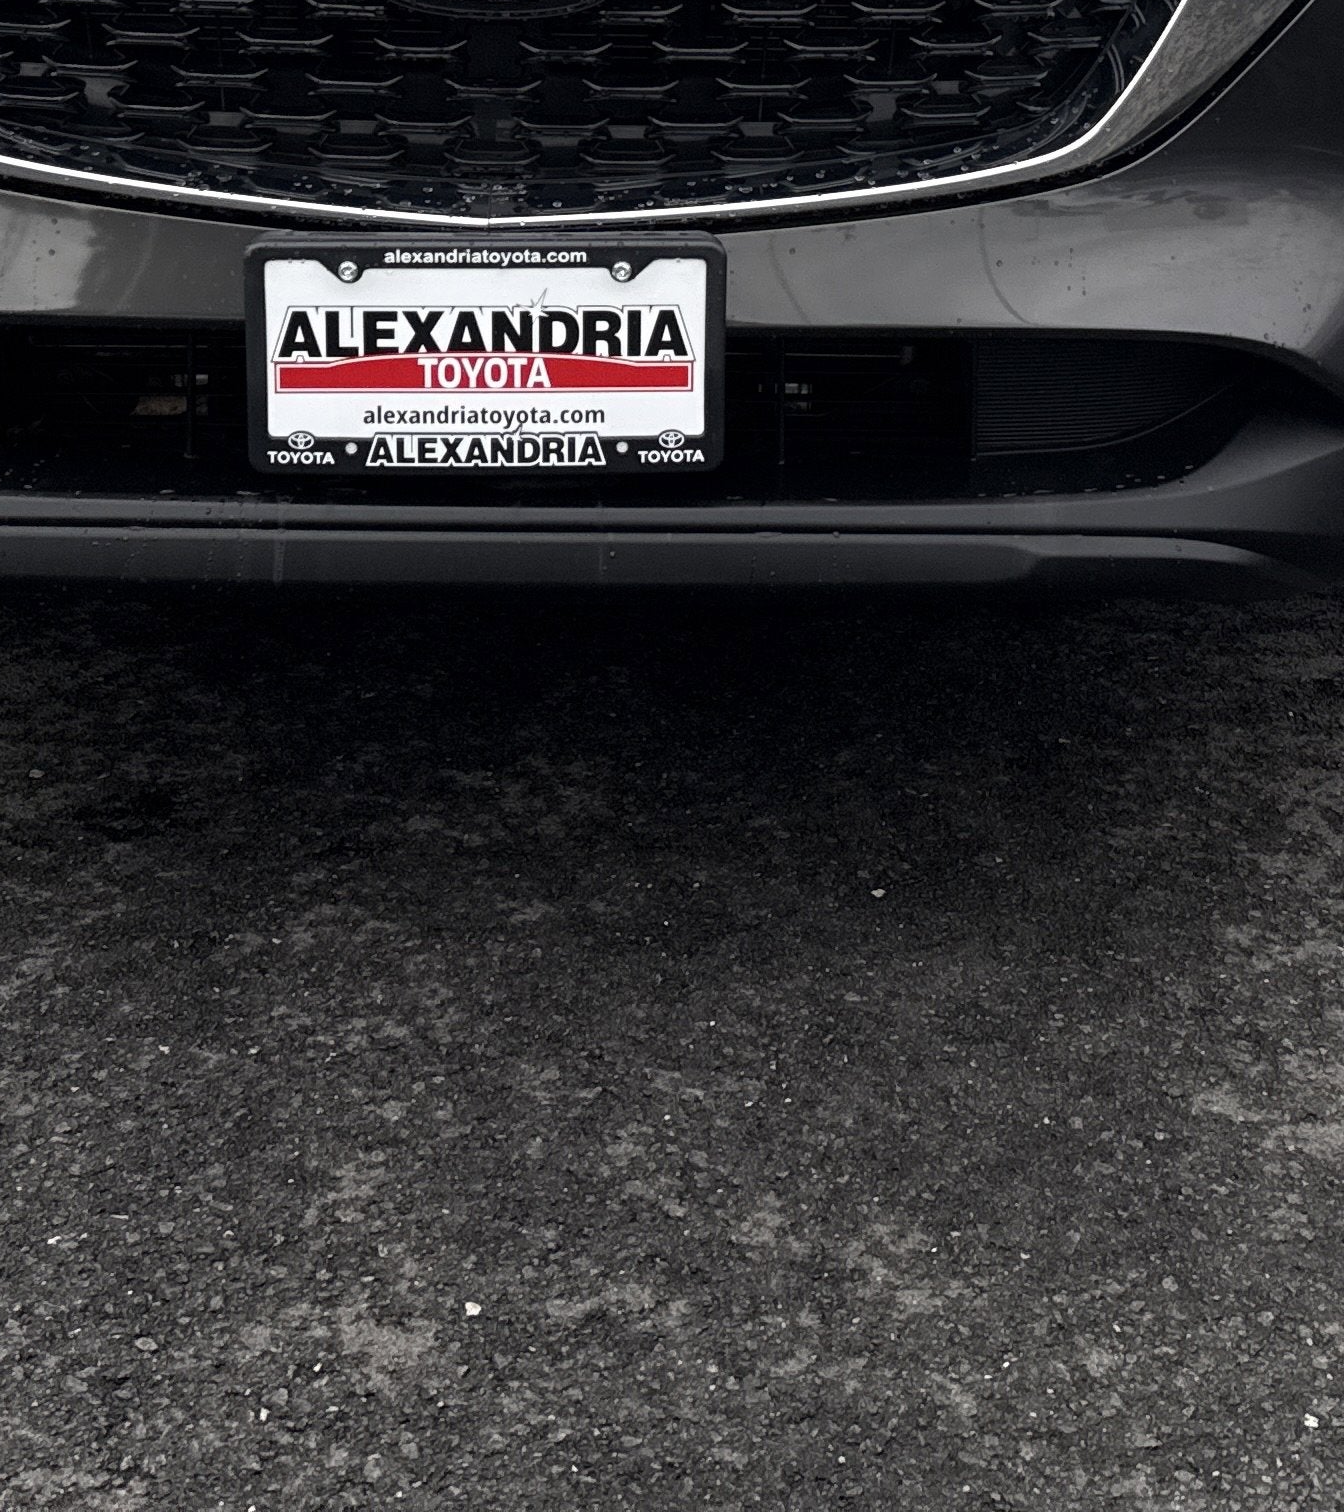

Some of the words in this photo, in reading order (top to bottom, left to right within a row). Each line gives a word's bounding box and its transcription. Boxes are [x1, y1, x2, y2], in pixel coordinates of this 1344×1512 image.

[383, 248, 587, 267] alexandriatoyota.com
[277, 308, 689, 359] ALEXANDRIA
[416, 357, 552, 389] TOYOTA
[362, 405, 606, 430] alexandriatoyota.com
[266, 450, 335, 465] TOYOTA
[368, 435, 605, 465] ALEXANDRIA
[636, 449, 706, 464] TOYOTA
